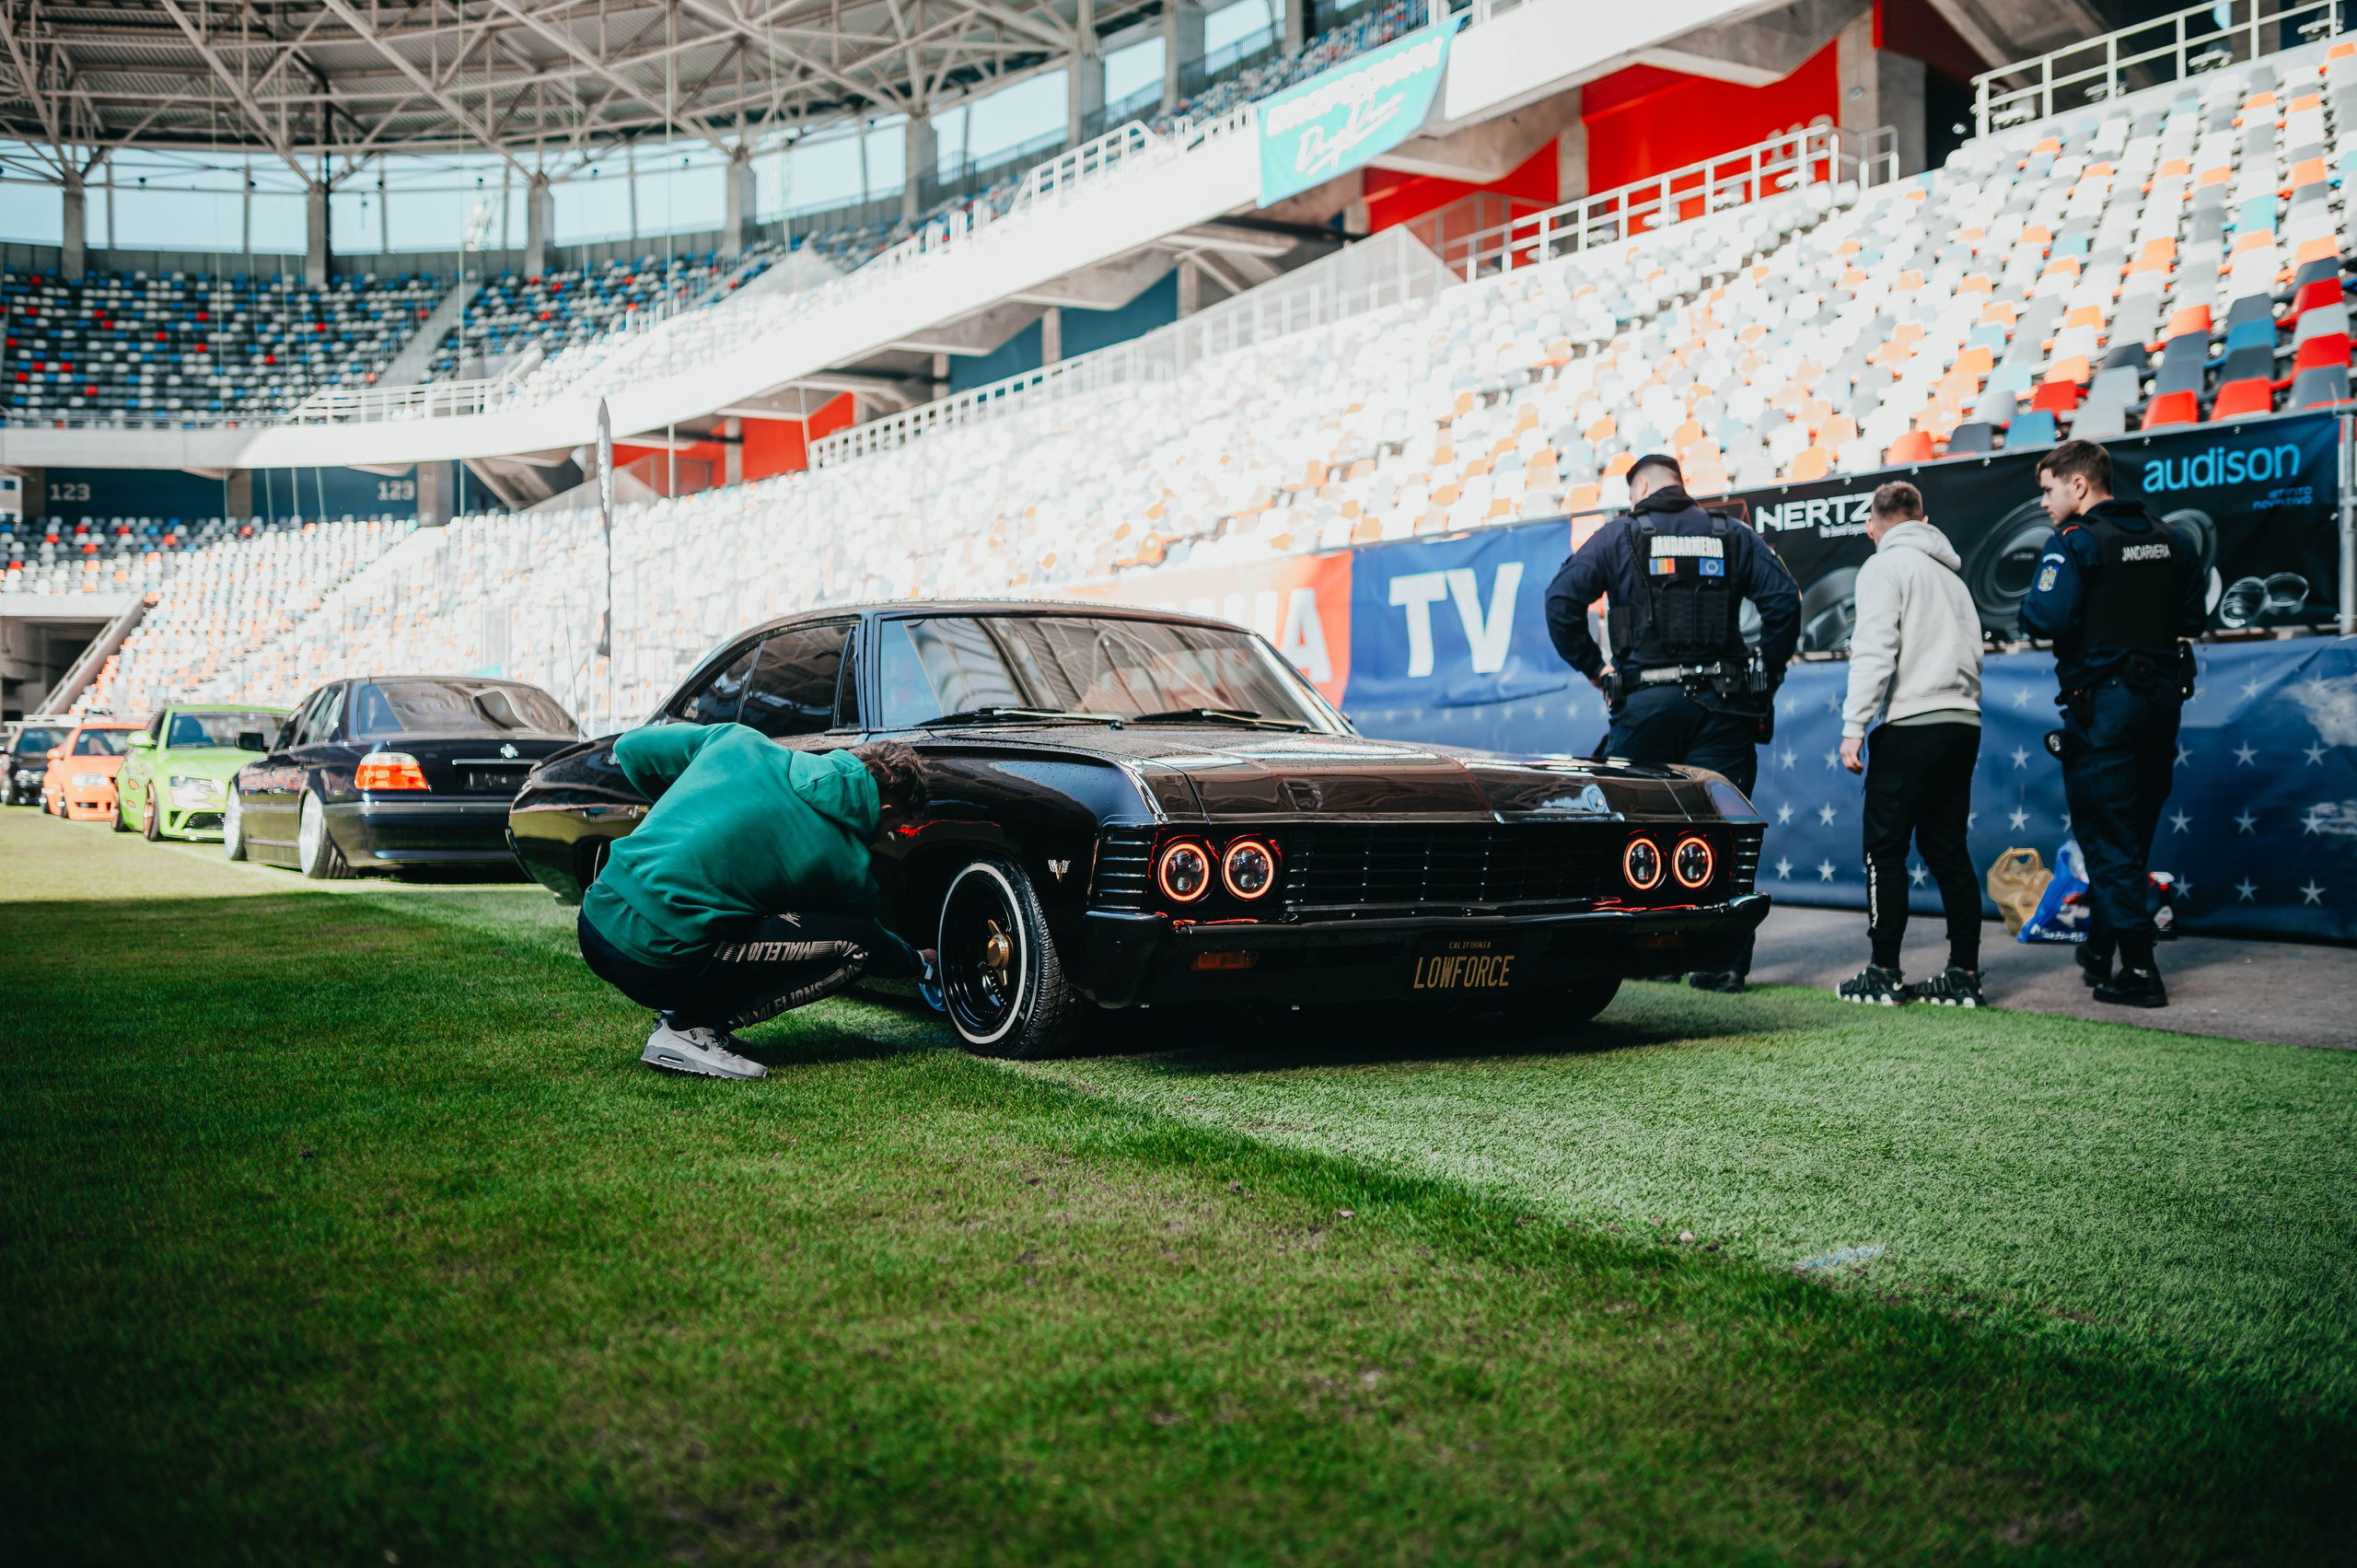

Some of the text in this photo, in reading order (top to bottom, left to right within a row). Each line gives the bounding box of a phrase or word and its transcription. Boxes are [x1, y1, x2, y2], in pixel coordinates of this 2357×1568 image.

[2142, 444, 2300, 493] audison
[51, 482, 90, 501] 123
[377, 481, 414, 500] 123
[1756, 493, 1872, 533] HERTZ
[1388, 562, 1524, 678] TV
[1448, 941, 1491, 949] CALIFORNIA
[1413, 955, 1515, 989] LOWFORCE
